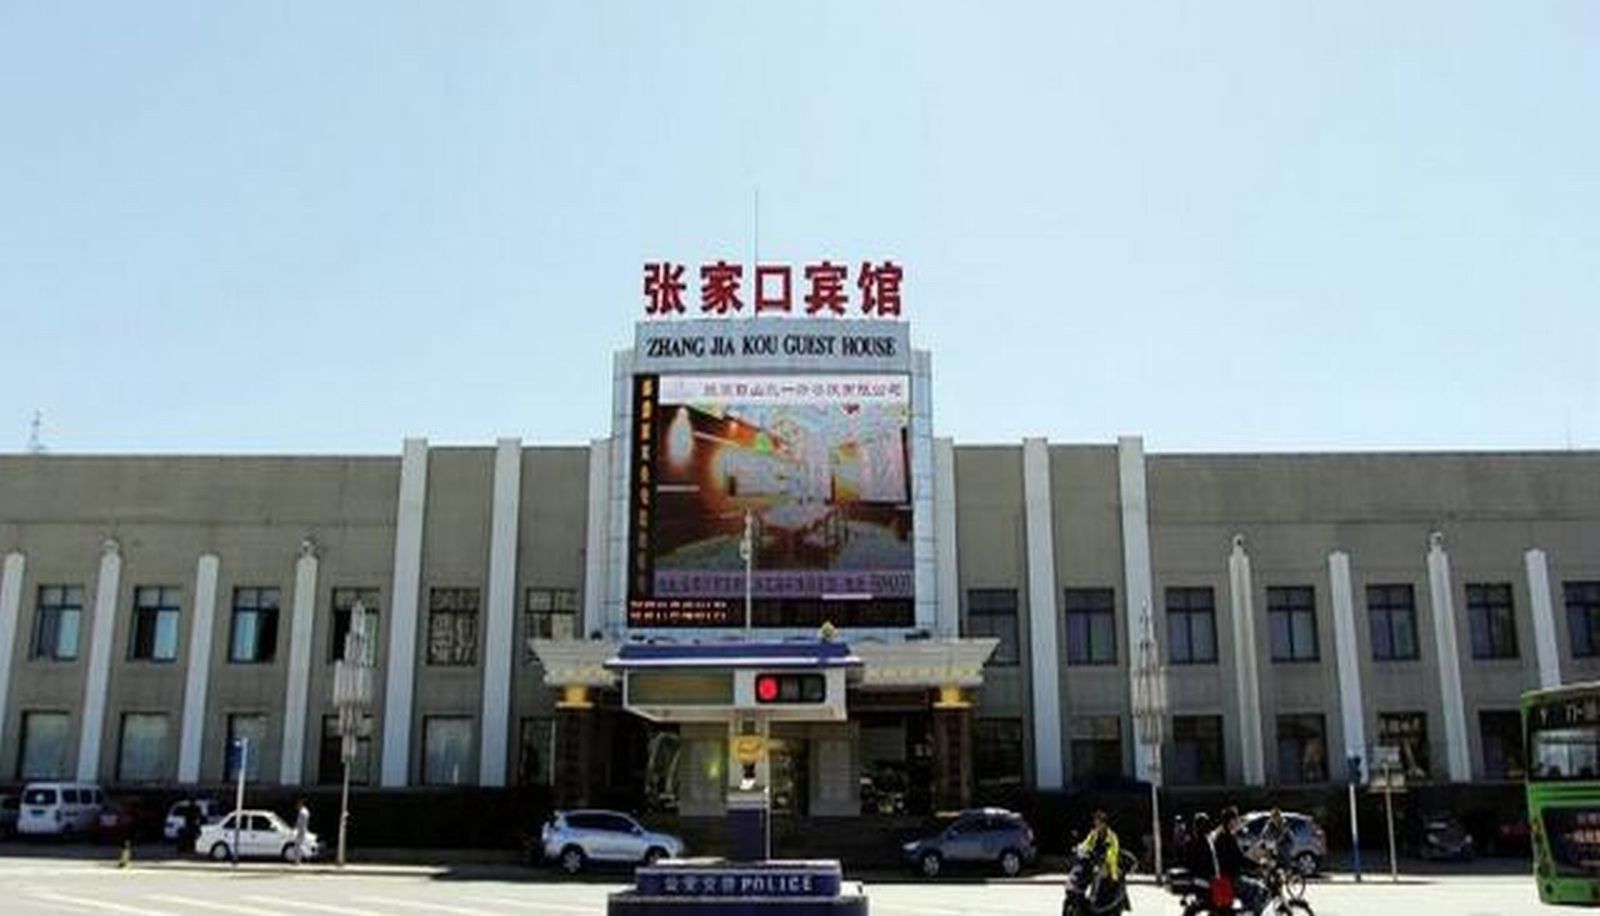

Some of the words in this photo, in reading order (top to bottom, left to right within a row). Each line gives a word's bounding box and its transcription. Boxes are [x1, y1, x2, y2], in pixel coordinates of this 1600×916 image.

[643, 261, 905, 316] 张家口宾馆
[647, 337, 705, 358] ZHANG
[709, 336, 736, 357] JIA
[742, 335, 778, 356] KOU
[783, 334, 836, 357] GUEST
[842, 336, 897, 358] HOUSE
[741, 876, 813, 893] POLICE
